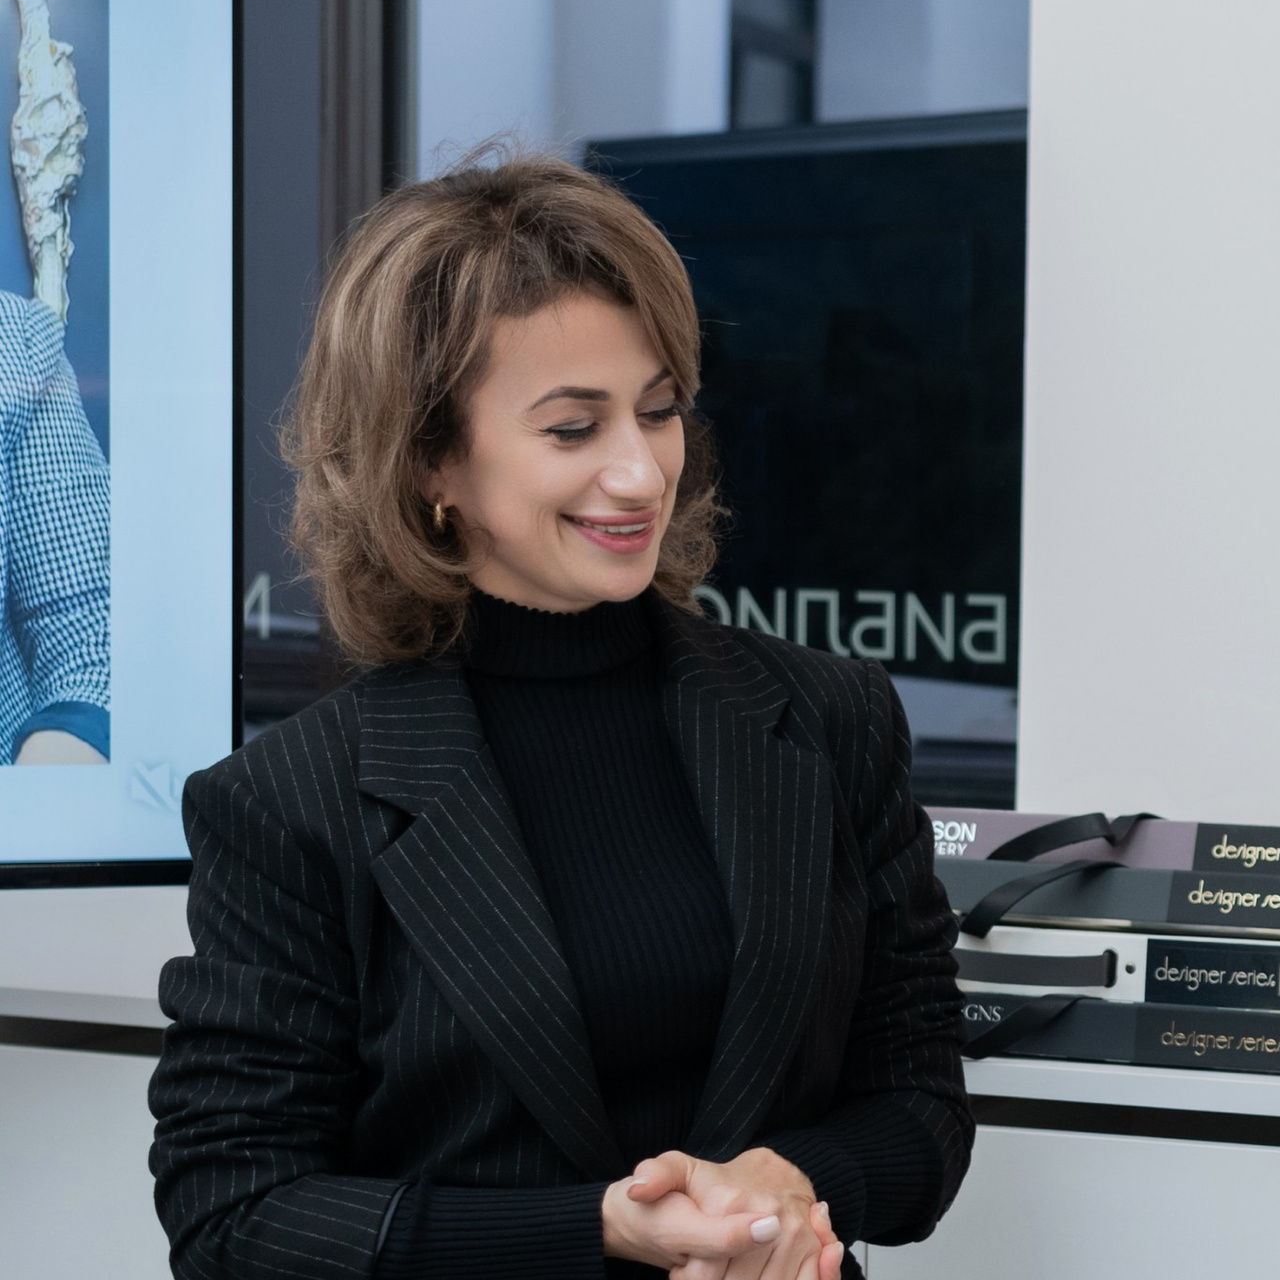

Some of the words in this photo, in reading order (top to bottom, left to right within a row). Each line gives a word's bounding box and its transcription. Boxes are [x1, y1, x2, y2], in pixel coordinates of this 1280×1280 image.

[932, 820, 977, 842] SON
[935, 841, 968, 856] ERY
[1188, 879, 1260, 914] designer
[1155, 955, 1226, 991] designer
[961, 1003, 1002, 1023] GNS
[1161, 1020, 1234, 1057] designer
